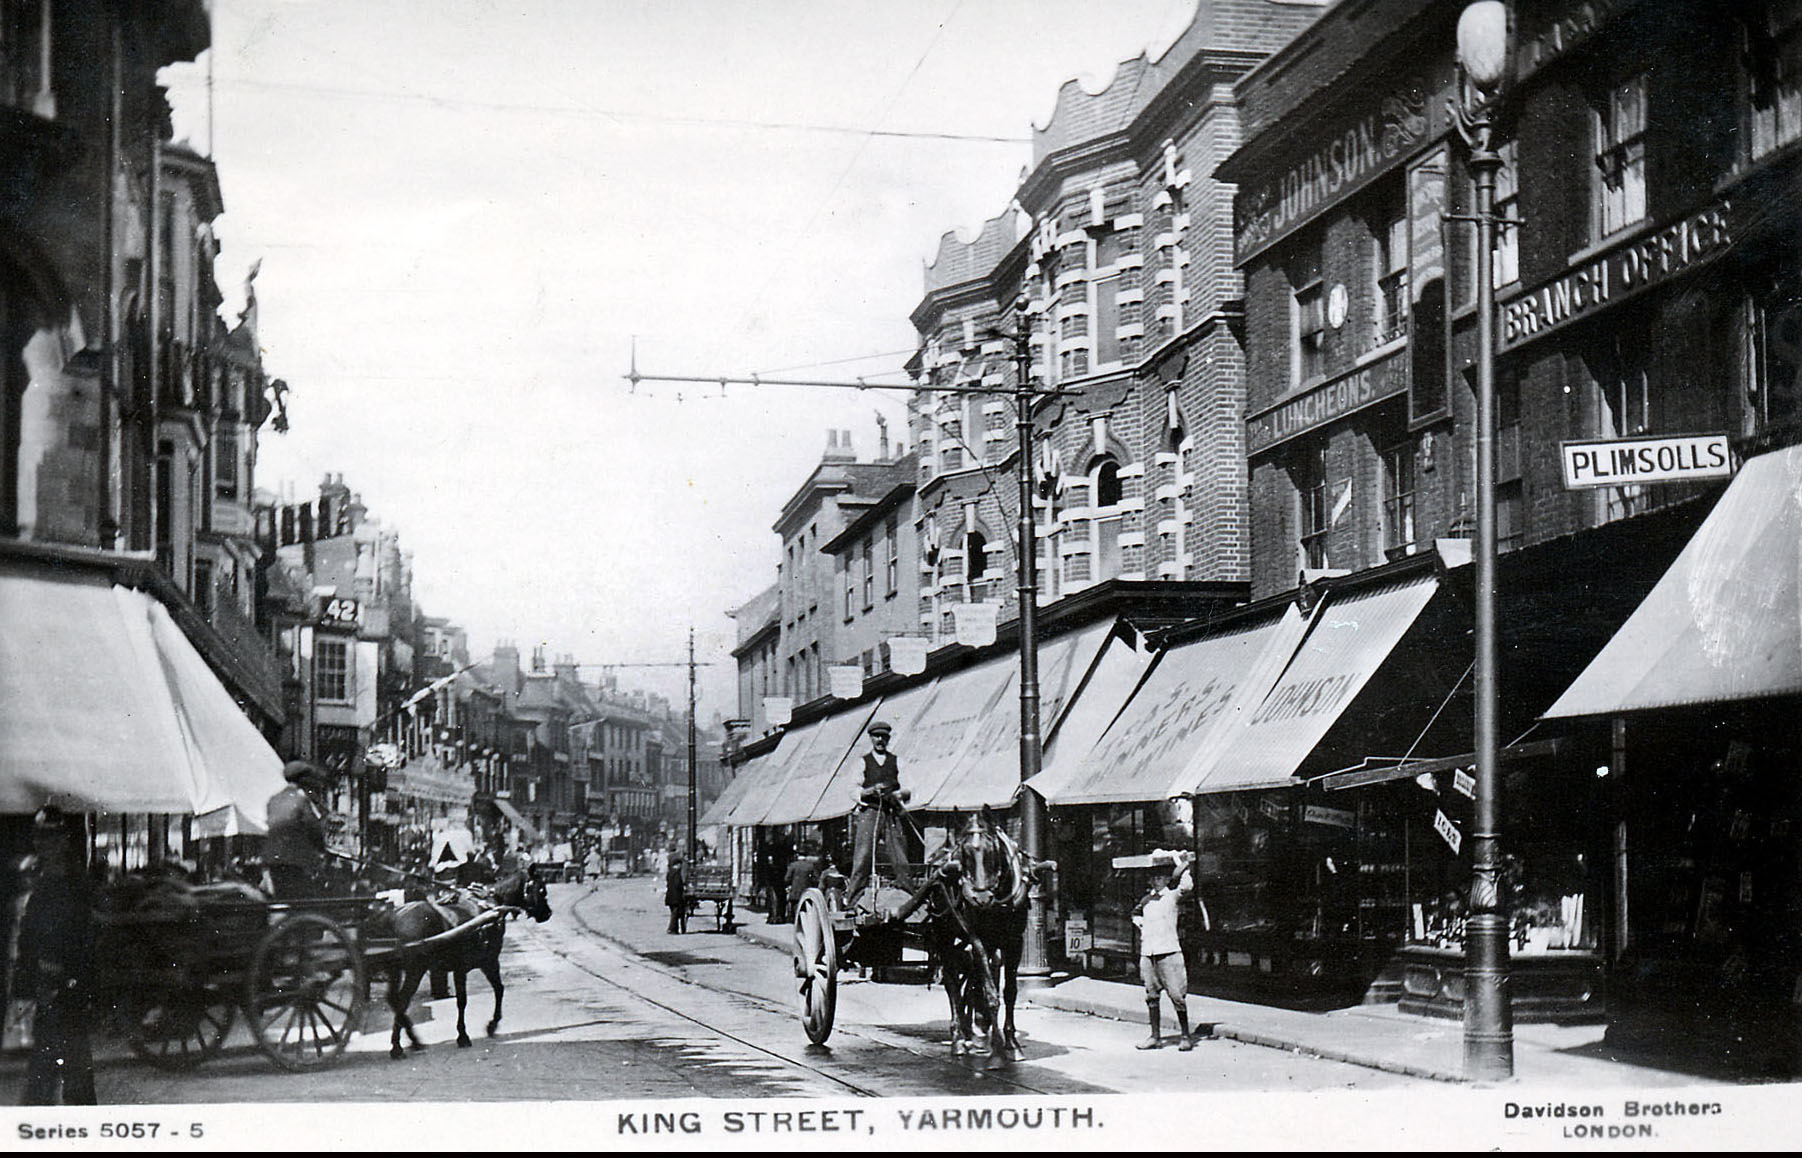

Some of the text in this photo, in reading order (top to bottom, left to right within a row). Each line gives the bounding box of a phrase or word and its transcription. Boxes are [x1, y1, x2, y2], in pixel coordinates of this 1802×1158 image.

[1506, 201, 1732, 340] BRANCH OFFICE
[1572, 442, 1726, 480] PLIMSOLLS
[1251, 672, 1362, 726] JOHNSON
